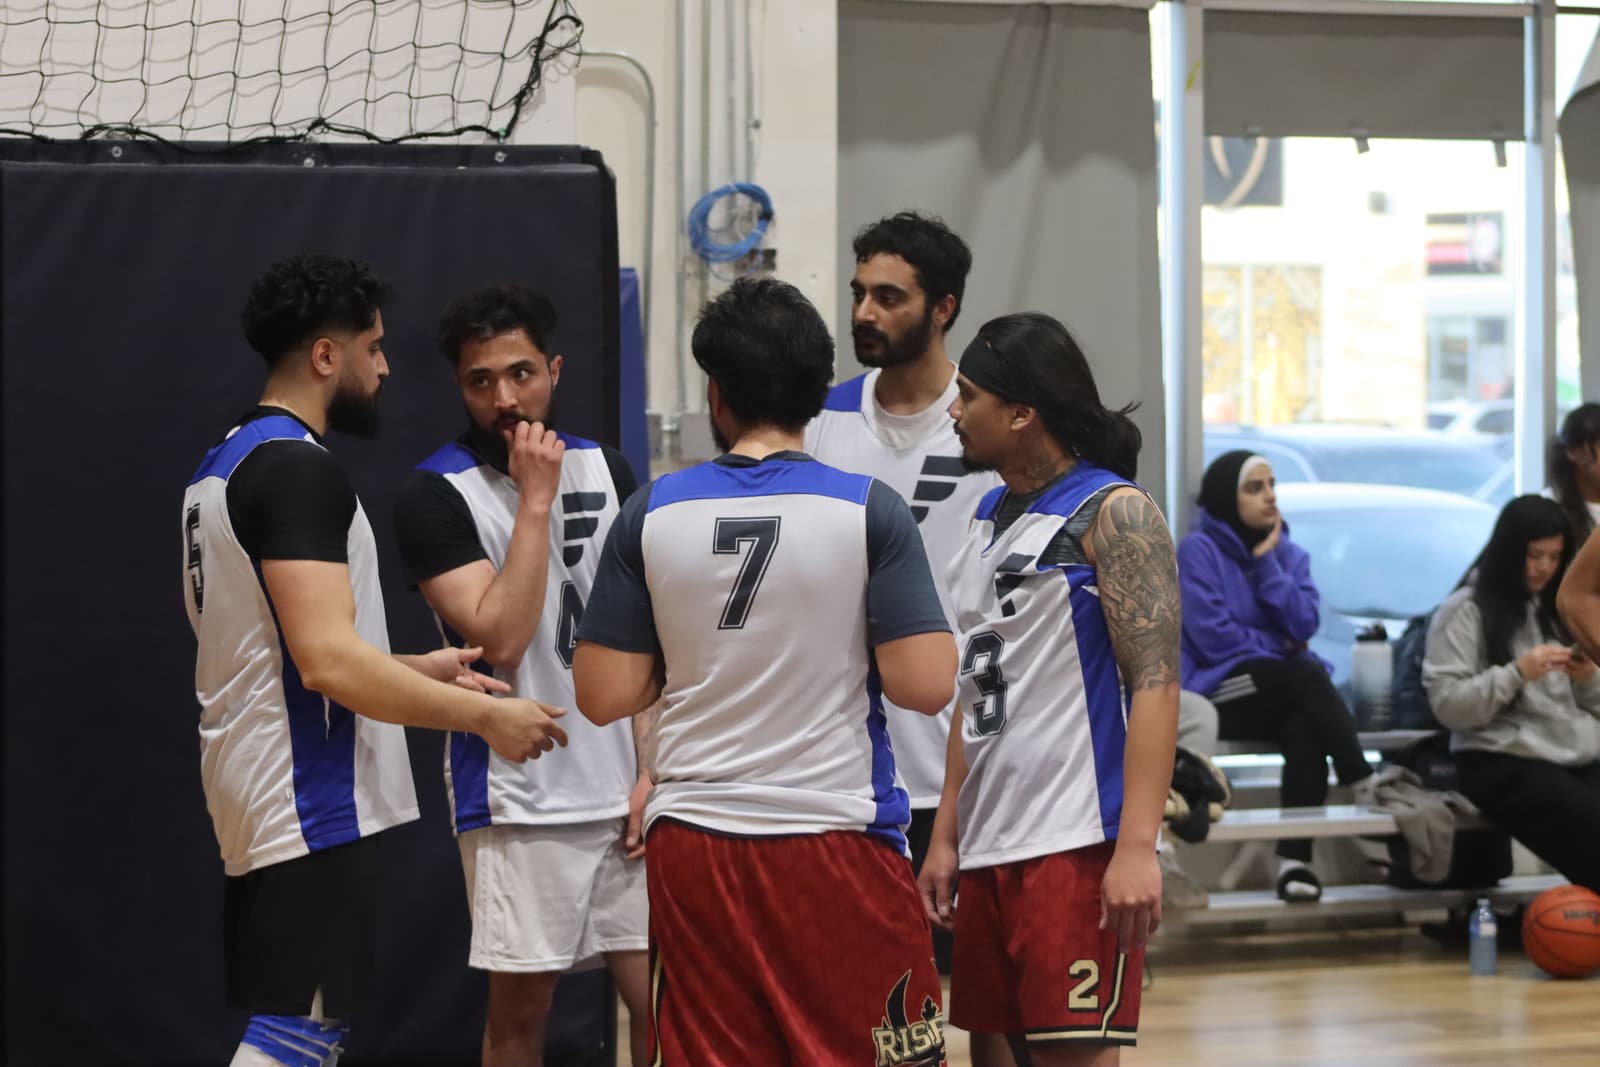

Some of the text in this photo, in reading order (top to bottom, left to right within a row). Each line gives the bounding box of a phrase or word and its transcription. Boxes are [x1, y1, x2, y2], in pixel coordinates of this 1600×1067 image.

[713, 515, 781, 630] 7
[961, 631, 1008, 738] 3
[1068, 959, 1099, 1011] 2
